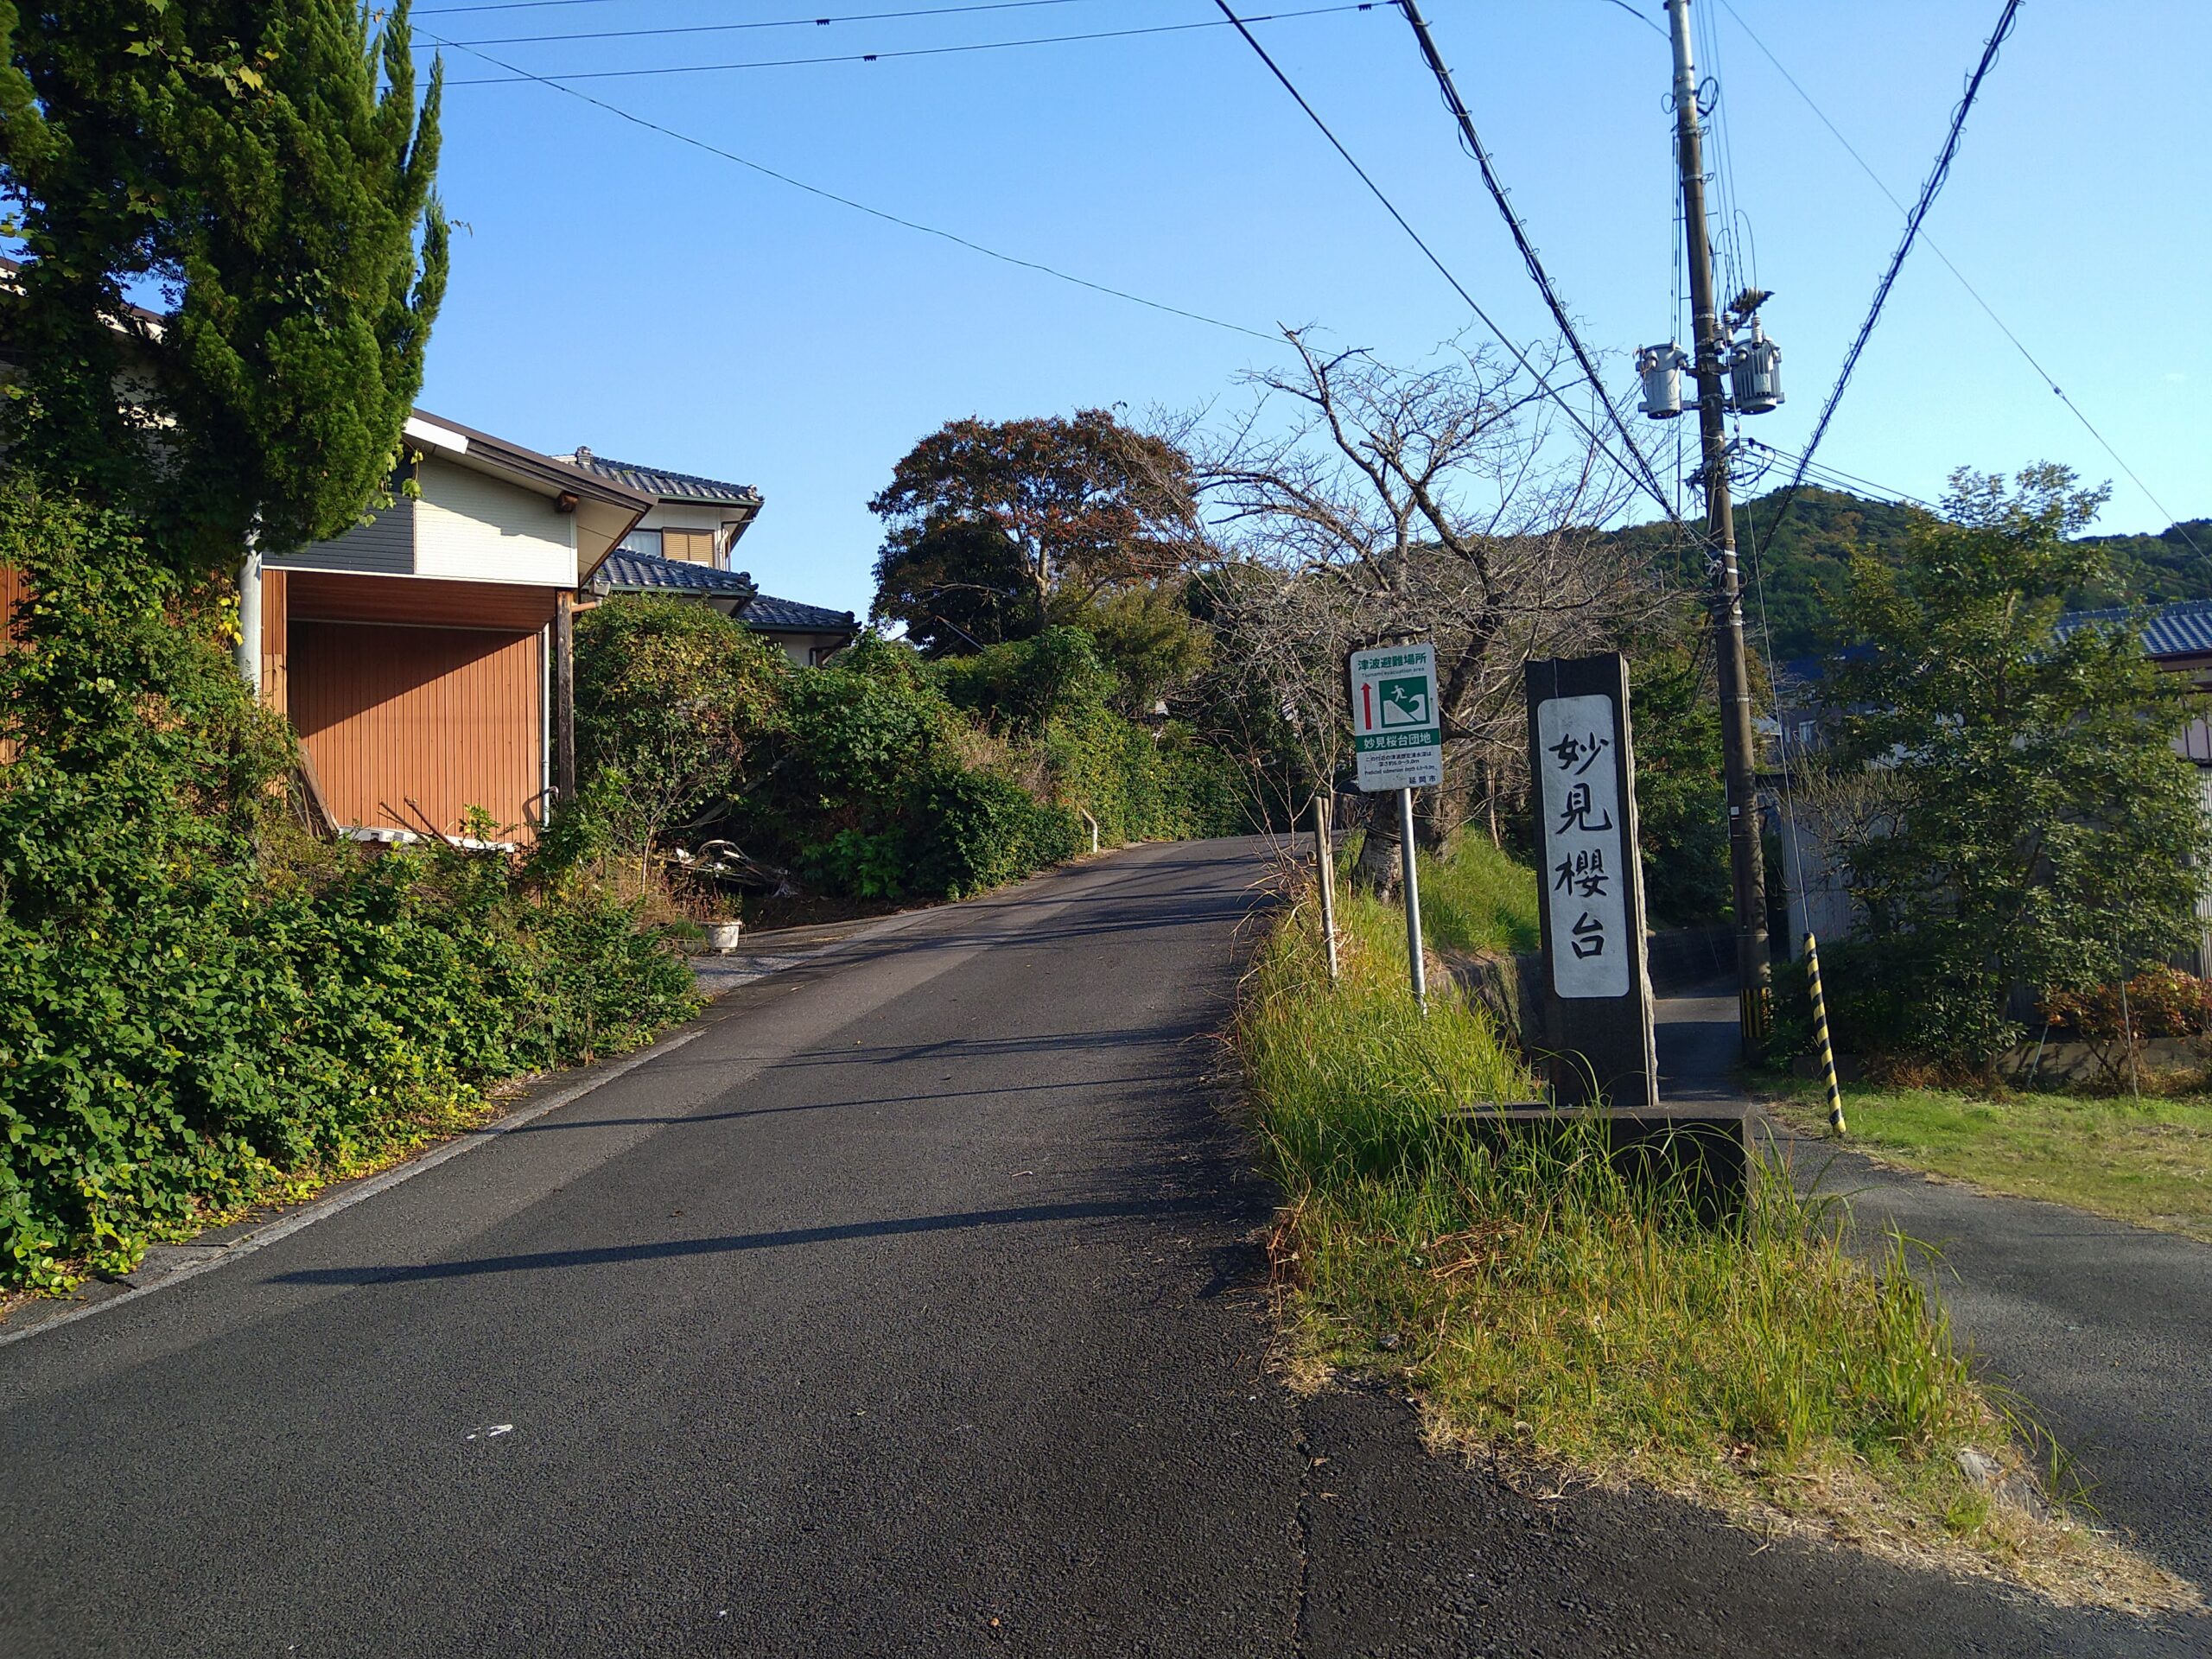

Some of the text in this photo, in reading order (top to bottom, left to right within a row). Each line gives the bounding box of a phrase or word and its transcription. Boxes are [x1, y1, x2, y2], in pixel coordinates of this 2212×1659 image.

[1357, 652, 1427, 671] 津波避難場所
[1363, 732, 1432, 749] 妙見桜台団地
[1408, 775, 1436, 785] 延岡市
[1548, 731, 1613, 960] 妙見櫻台
